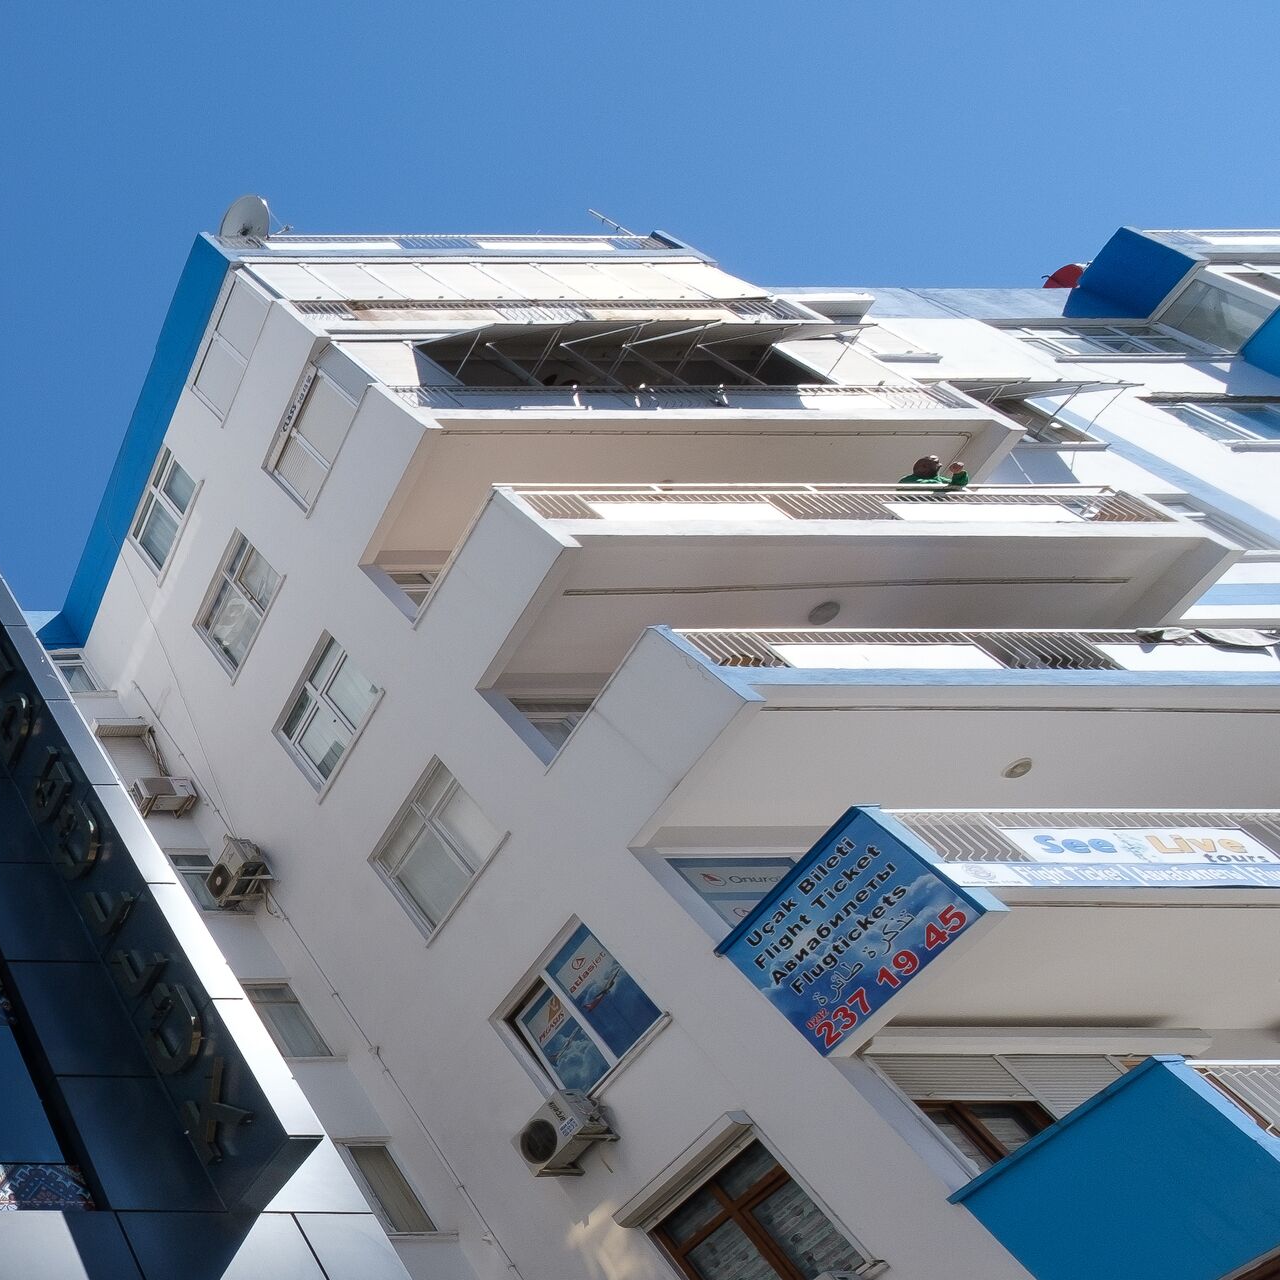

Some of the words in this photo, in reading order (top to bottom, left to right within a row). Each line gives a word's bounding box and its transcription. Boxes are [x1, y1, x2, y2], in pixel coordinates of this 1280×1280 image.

[745, 897, 799, 949] Uçak
[796, 836, 857, 897] Bileti
[1032, 833, 1118, 854] See
[1144, 833, 1249, 854] Live
[1203, 851, 1272, 864] tours
[752, 912, 814, 971] Flight
[810, 844, 881, 912] Ticket
[771, 861, 898, 986] Авиабилеты
[790, 884, 908, 996] Flugtickets
[815, 986, 872, 1049] 237
[876, 949, 920, 989] 19
[923, 903, 968, 951] 45
